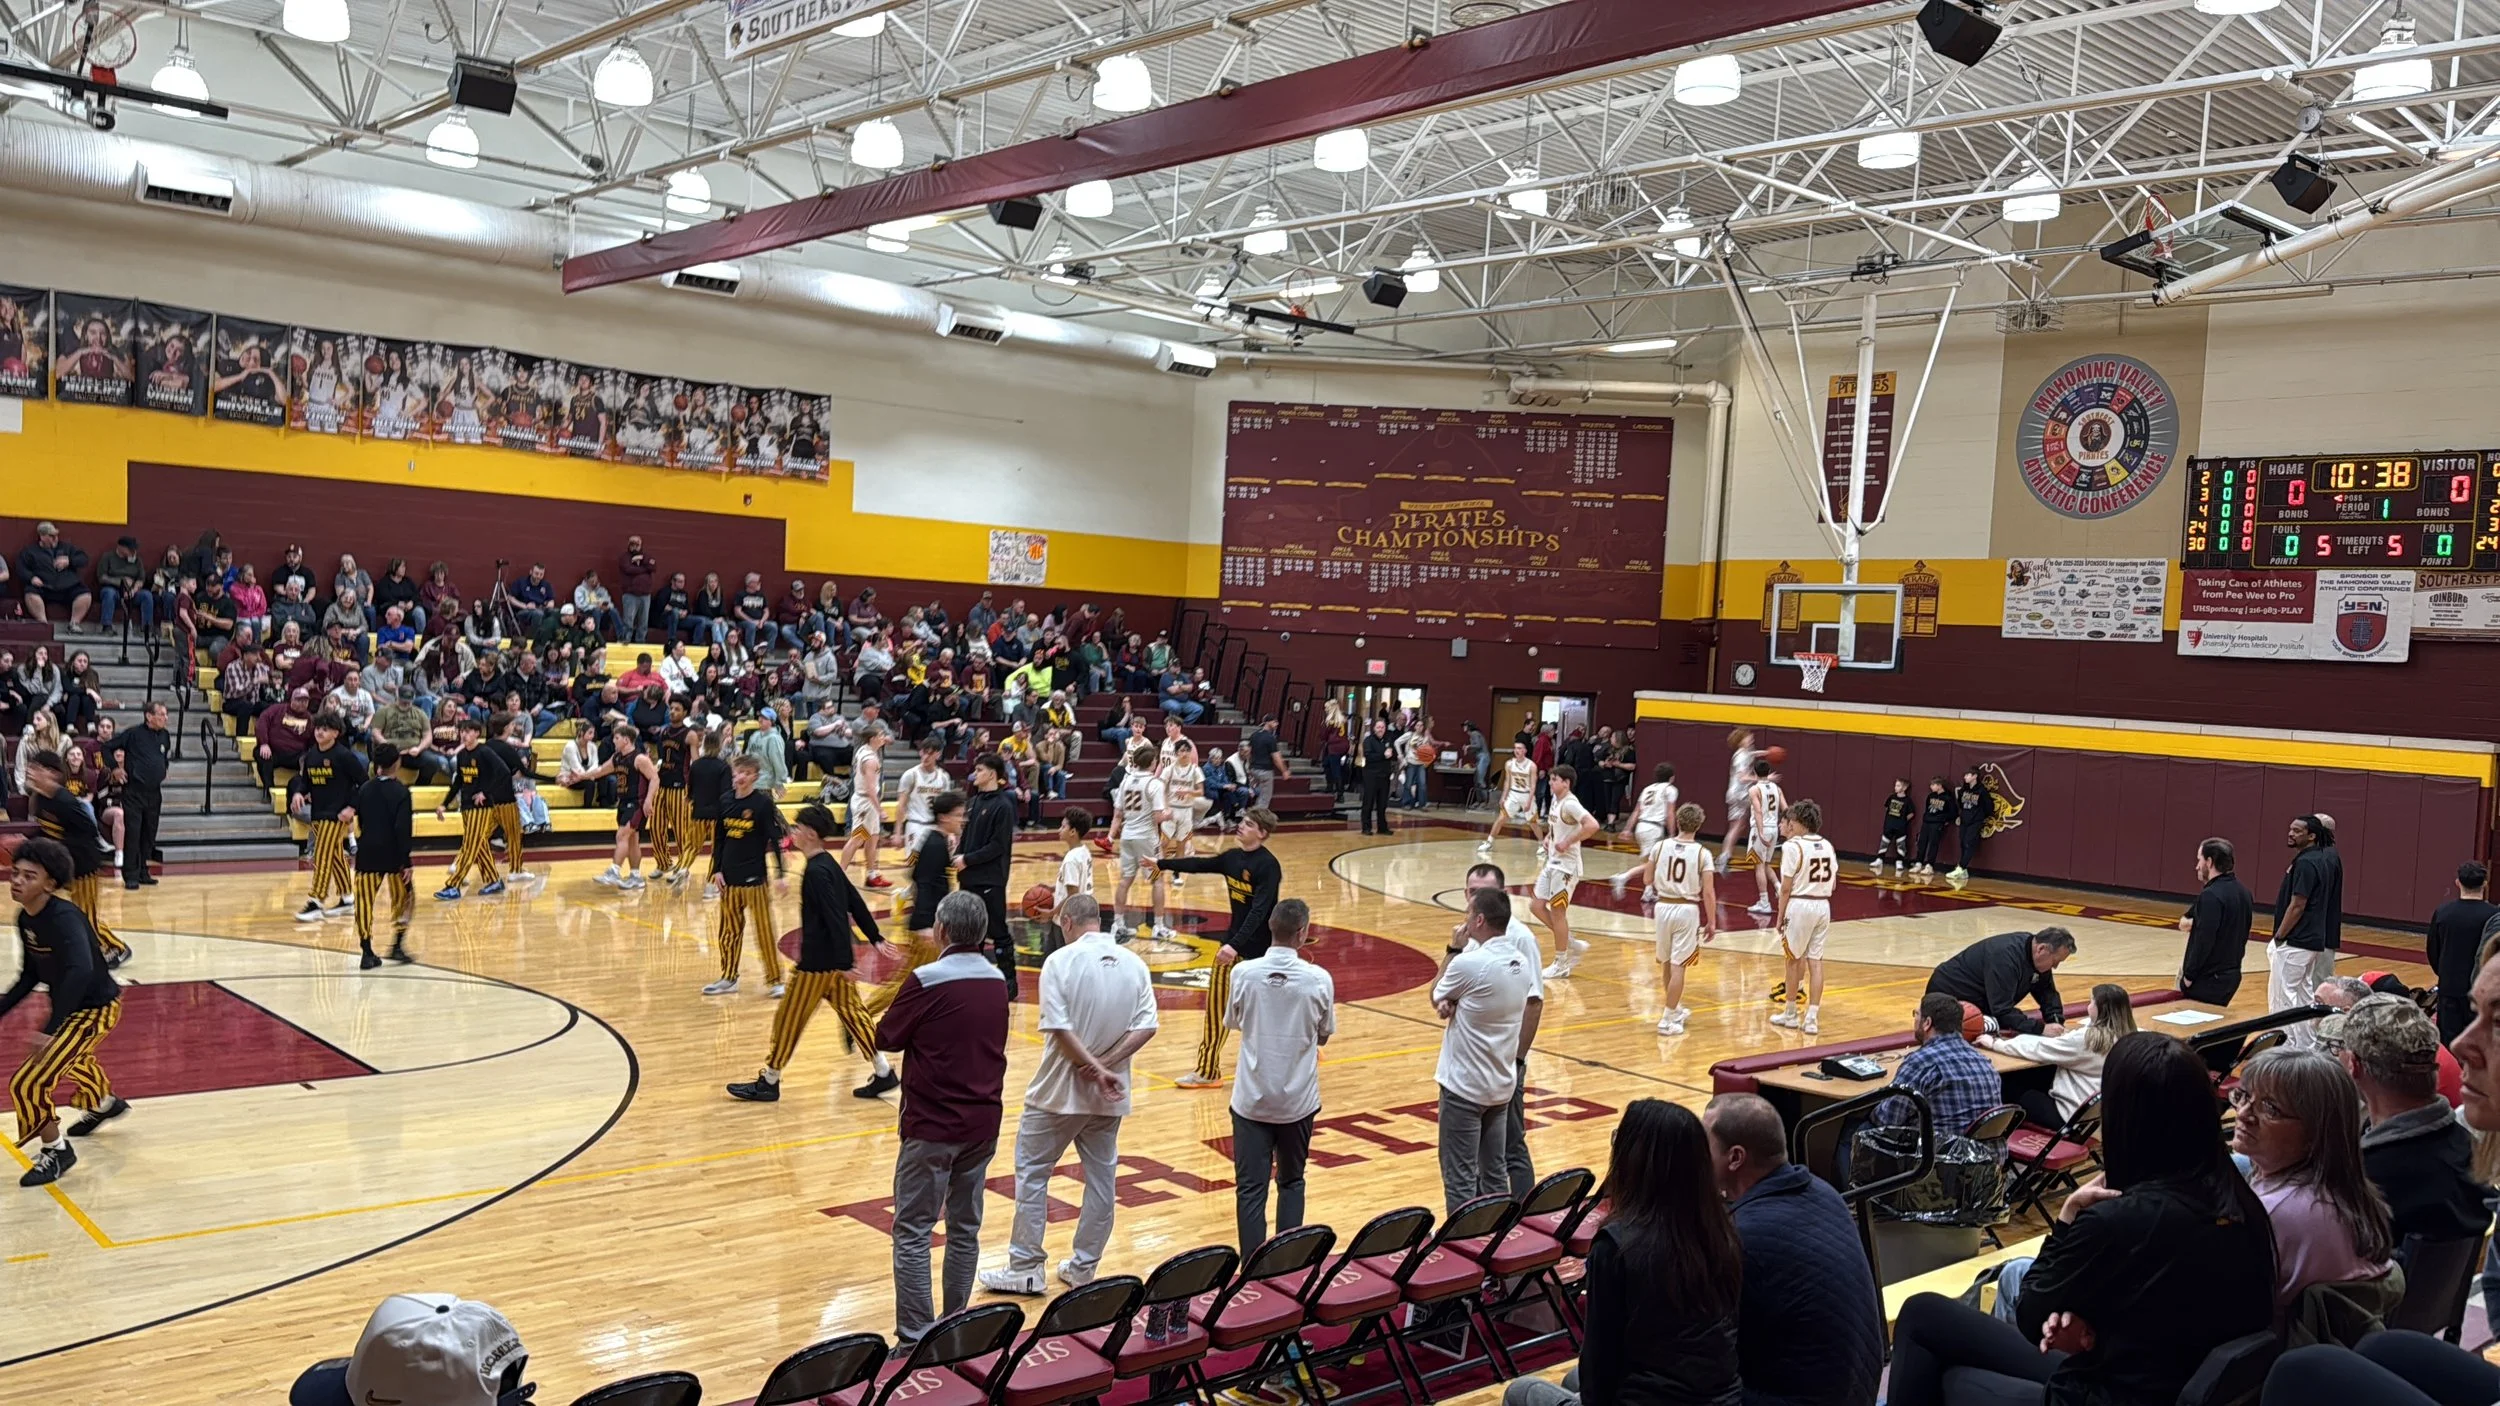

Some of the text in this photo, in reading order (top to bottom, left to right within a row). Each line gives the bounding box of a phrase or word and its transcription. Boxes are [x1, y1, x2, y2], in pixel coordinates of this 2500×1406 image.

[2033, 361, 2168, 414] MAHONING VALLEY
[2078, 412, 2115, 427] SOUTHEAST
[2079, 450, 2110, 460] PIRATES
[2196, 460, 2256, 471] NO F PTS
[2268, 463, 2305, 475] HOME
[2422, 458, 2476, 471] VISITOR
[2023, 451, 2168, 514] ATHLETIC CONFERENCE
[2201, 469, 2257, 485] 2 0 0
[2330, 461, 2411, 489] 10:38
[2200, 486, 2256, 502] 3 0 0
[2287, 479, 2306, 505] 0
[2450, 475, 2471, 503] 0
[2344, 494, 2363, 502] POSS
[2198, 503, 2255, 518] 4 0 0
[2278, 509, 2309, 519] BONUS
[2335, 502, 2370, 512] PERIOD
[2382, 498, 2389, 519] 1
[2416, 507, 2451, 517] BONUS
[2489, 499, 2500, 514] 2
[1389, 509, 1506, 530] PIRATES
[2188, 519, 2254, 535] 24 0 0
[2489, 517, 2500, 532] 3
[2272, 525, 2301, 534] FOULS
[2423, 524, 2455, 533] FOULS
[1337, 525, 1560, 551] CHAMPIONSHIPS
[2187, 536, 2253, 551] 30 0 0
[2317, 534, 2403, 556] 5 TIMEOUTS 5
[2436, 534, 2453, 556] 0
[2475, 535, 2499, 550] 24
[2285, 535, 2299, 557] 0
[2347, 546, 2370, 555] LEFT
[2269, 557, 2299, 565] POINTS
[2420, 557, 2453, 566] POINTS
[2196, 578, 2303, 589] Taking Care of Athletes
[2419, 574, 2491, 589] SOUTHEAST
[2202, 589, 2296, 600] from Pee Wee to Pro
[2429, 592, 2469, 604] EDINBURG
[2192, 604, 2244, 615] UHSports.org
[2249, 606, 2304, 615] 216-983-PLAY
[2344, 601, 2382, 611] YSN
[2203, 633, 2268, 642] University Hospitals
[2230, 641, 2250, 649] Sports
[2331, 639, 2389, 659] YOUR SPORTS NETWORK
[312, 777, 326, 785] ME
[1124, 790, 1142, 811] 22
[1668, 856, 1687, 883] 10
[1808, 857, 1832, 883] 23
